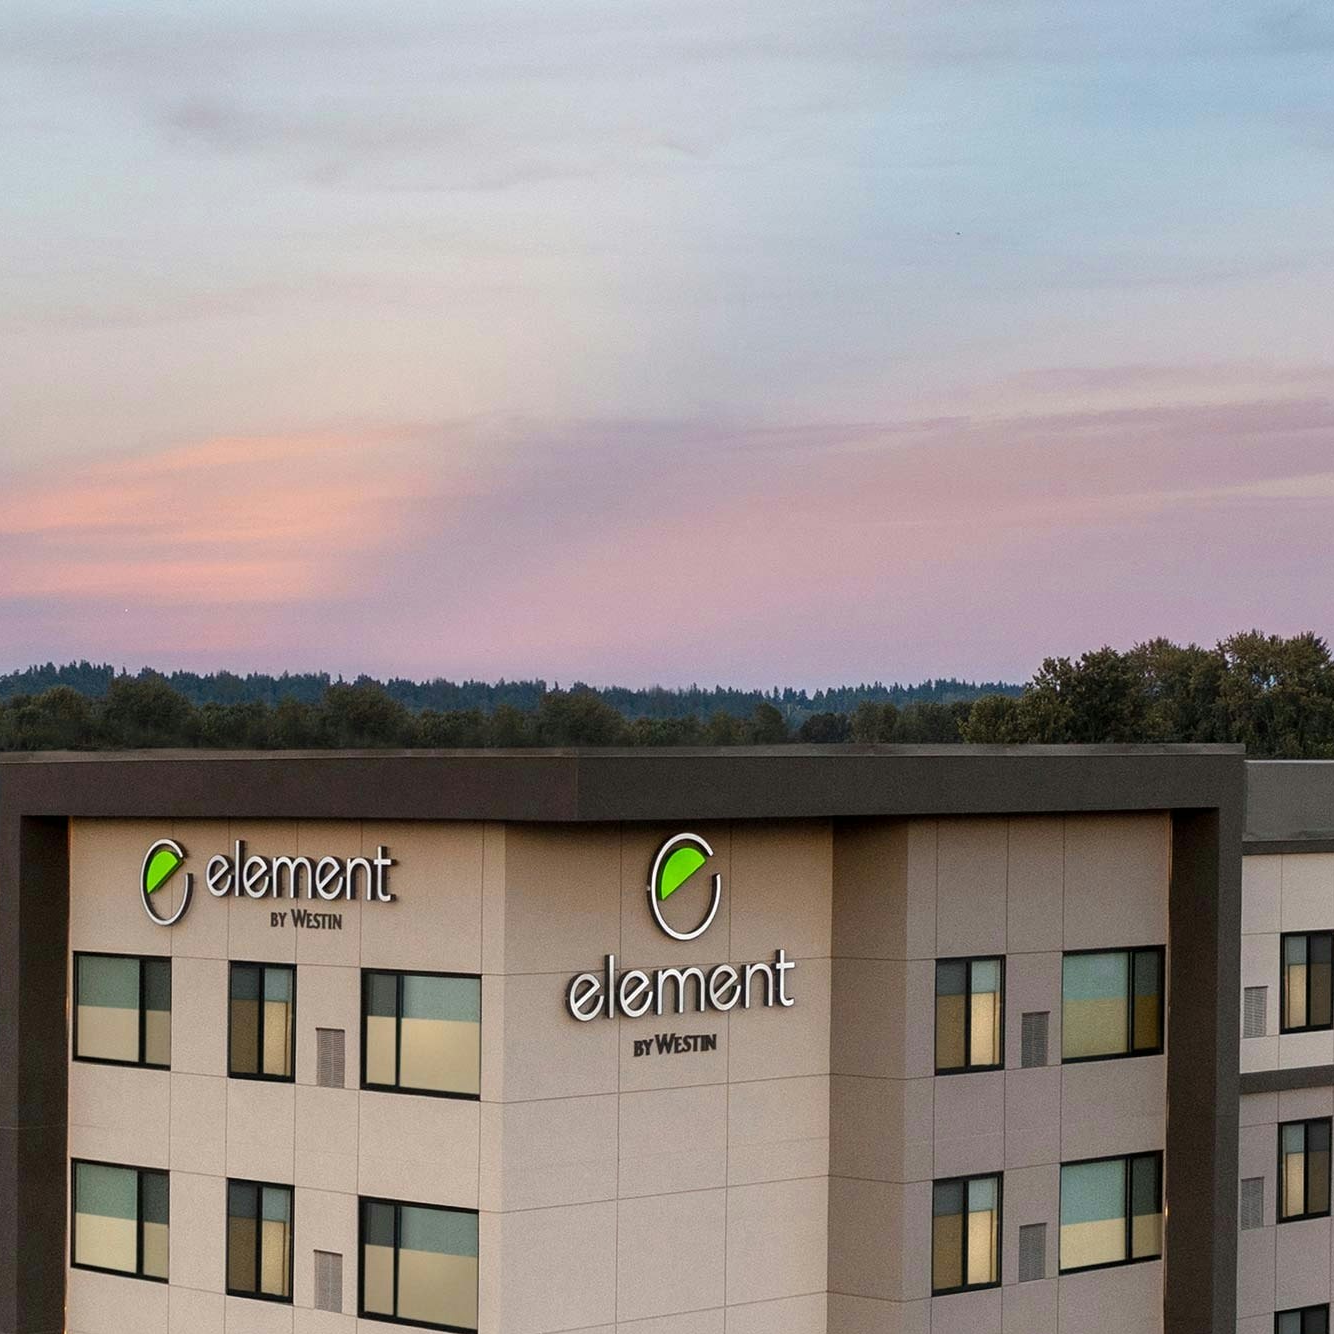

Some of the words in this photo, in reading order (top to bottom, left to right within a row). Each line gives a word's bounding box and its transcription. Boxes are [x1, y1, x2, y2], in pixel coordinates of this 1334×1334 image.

[205, 840, 395, 902] element
[270, 912, 287, 928] BY
[569, 949, 795, 1022] element
[633, 1039, 654, 1057] BY
